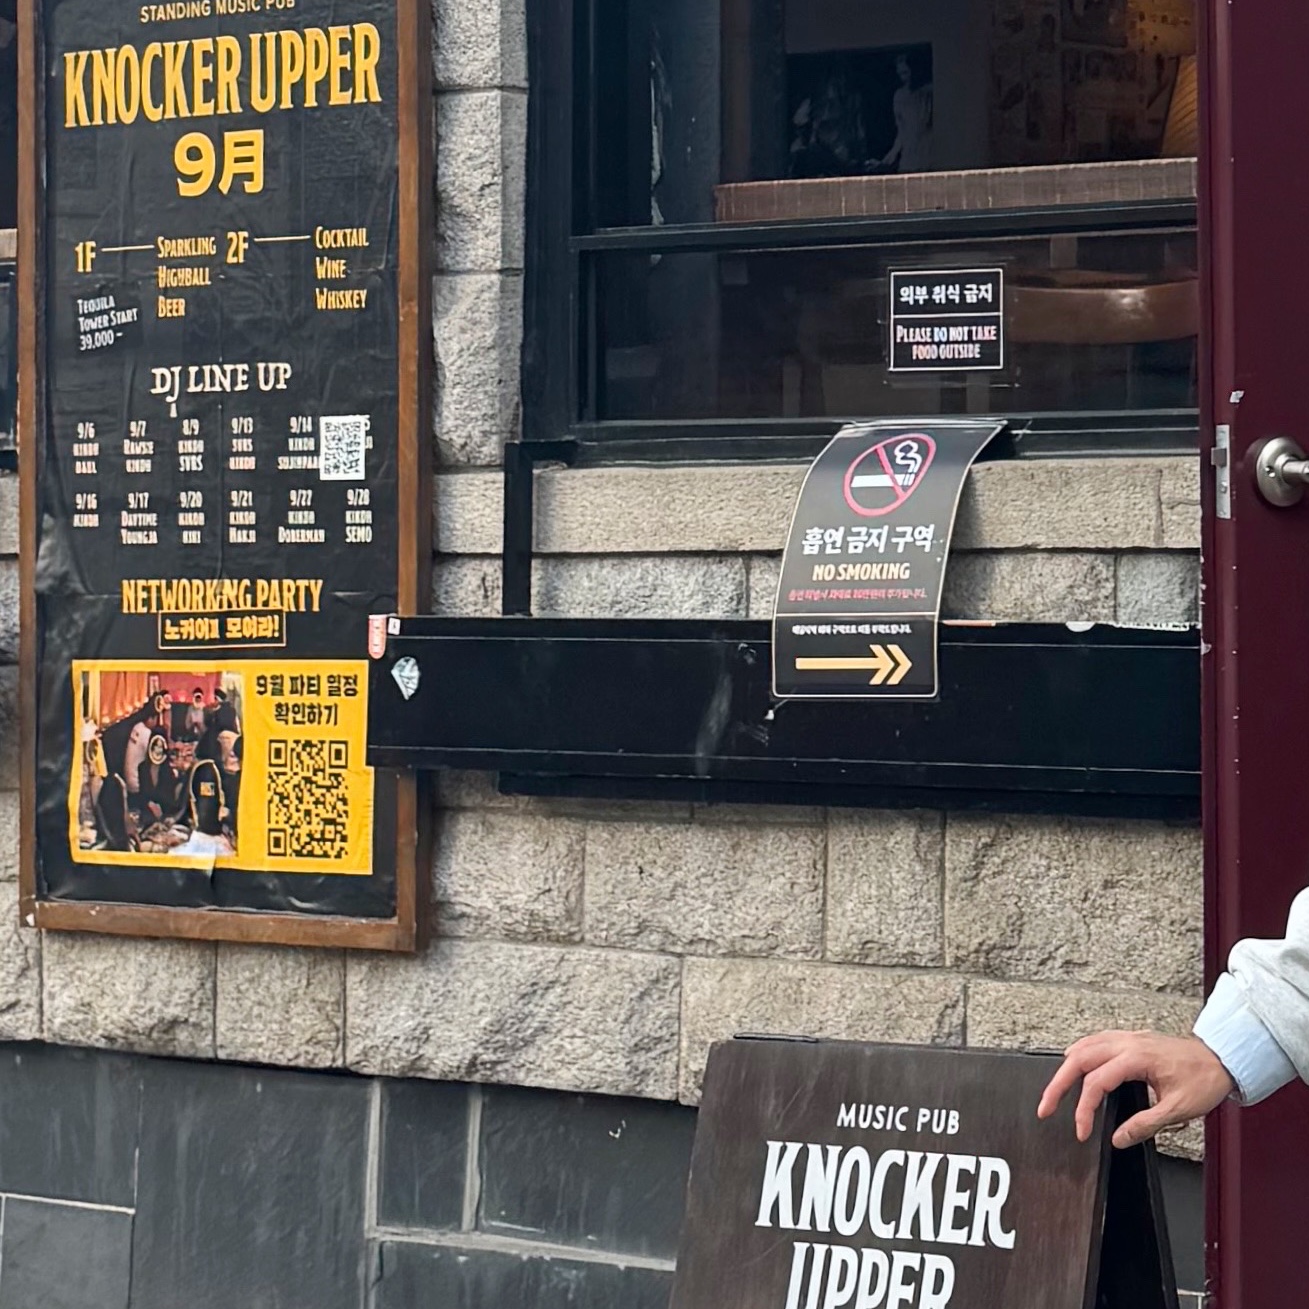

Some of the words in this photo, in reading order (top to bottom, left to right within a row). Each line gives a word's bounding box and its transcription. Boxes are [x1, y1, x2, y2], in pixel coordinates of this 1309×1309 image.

[140, 1, 211, 23] STANDING
[216, 0, 261, 14] MUSIC
[64, 35, 243, 128] KNOCKER
[249, 22, 382, 113] UPPER
[174, 129, 265, 197] 9月
[75, 241, 96, 272] 1F
[226, 231, 249, 264] 2F
[963, 283, 993, 303] 금지
[912, 344, 938, 360] FOOD
[939, 343, 981, 359] OUTSIDE
[150, 366, 182, 403] DJ
[186, 363, 249, 393] LINE
[257, 362, 292, 391] UP
[802, 526, 845, 555] 흡연
[847, 525, 889, 554] 금지
[891, 524, 935, 553] 구역
[812, 563, 836, 581] NO
[836, 562, 910, 580] SMOKING
[255, 579, 323, 612] PARTY
[256, 674, 284, 696] 9월
[289, 674, 321, 696] 파티
[327, 674, 358, 696] 일정
[274, 702, 338, 726] 확인하기
[836, 1102, 909, 1132] MUSIC
[916, 1108, 960, 1135] PUB
[755, 1140, 1016, 1250] KNOCKER
